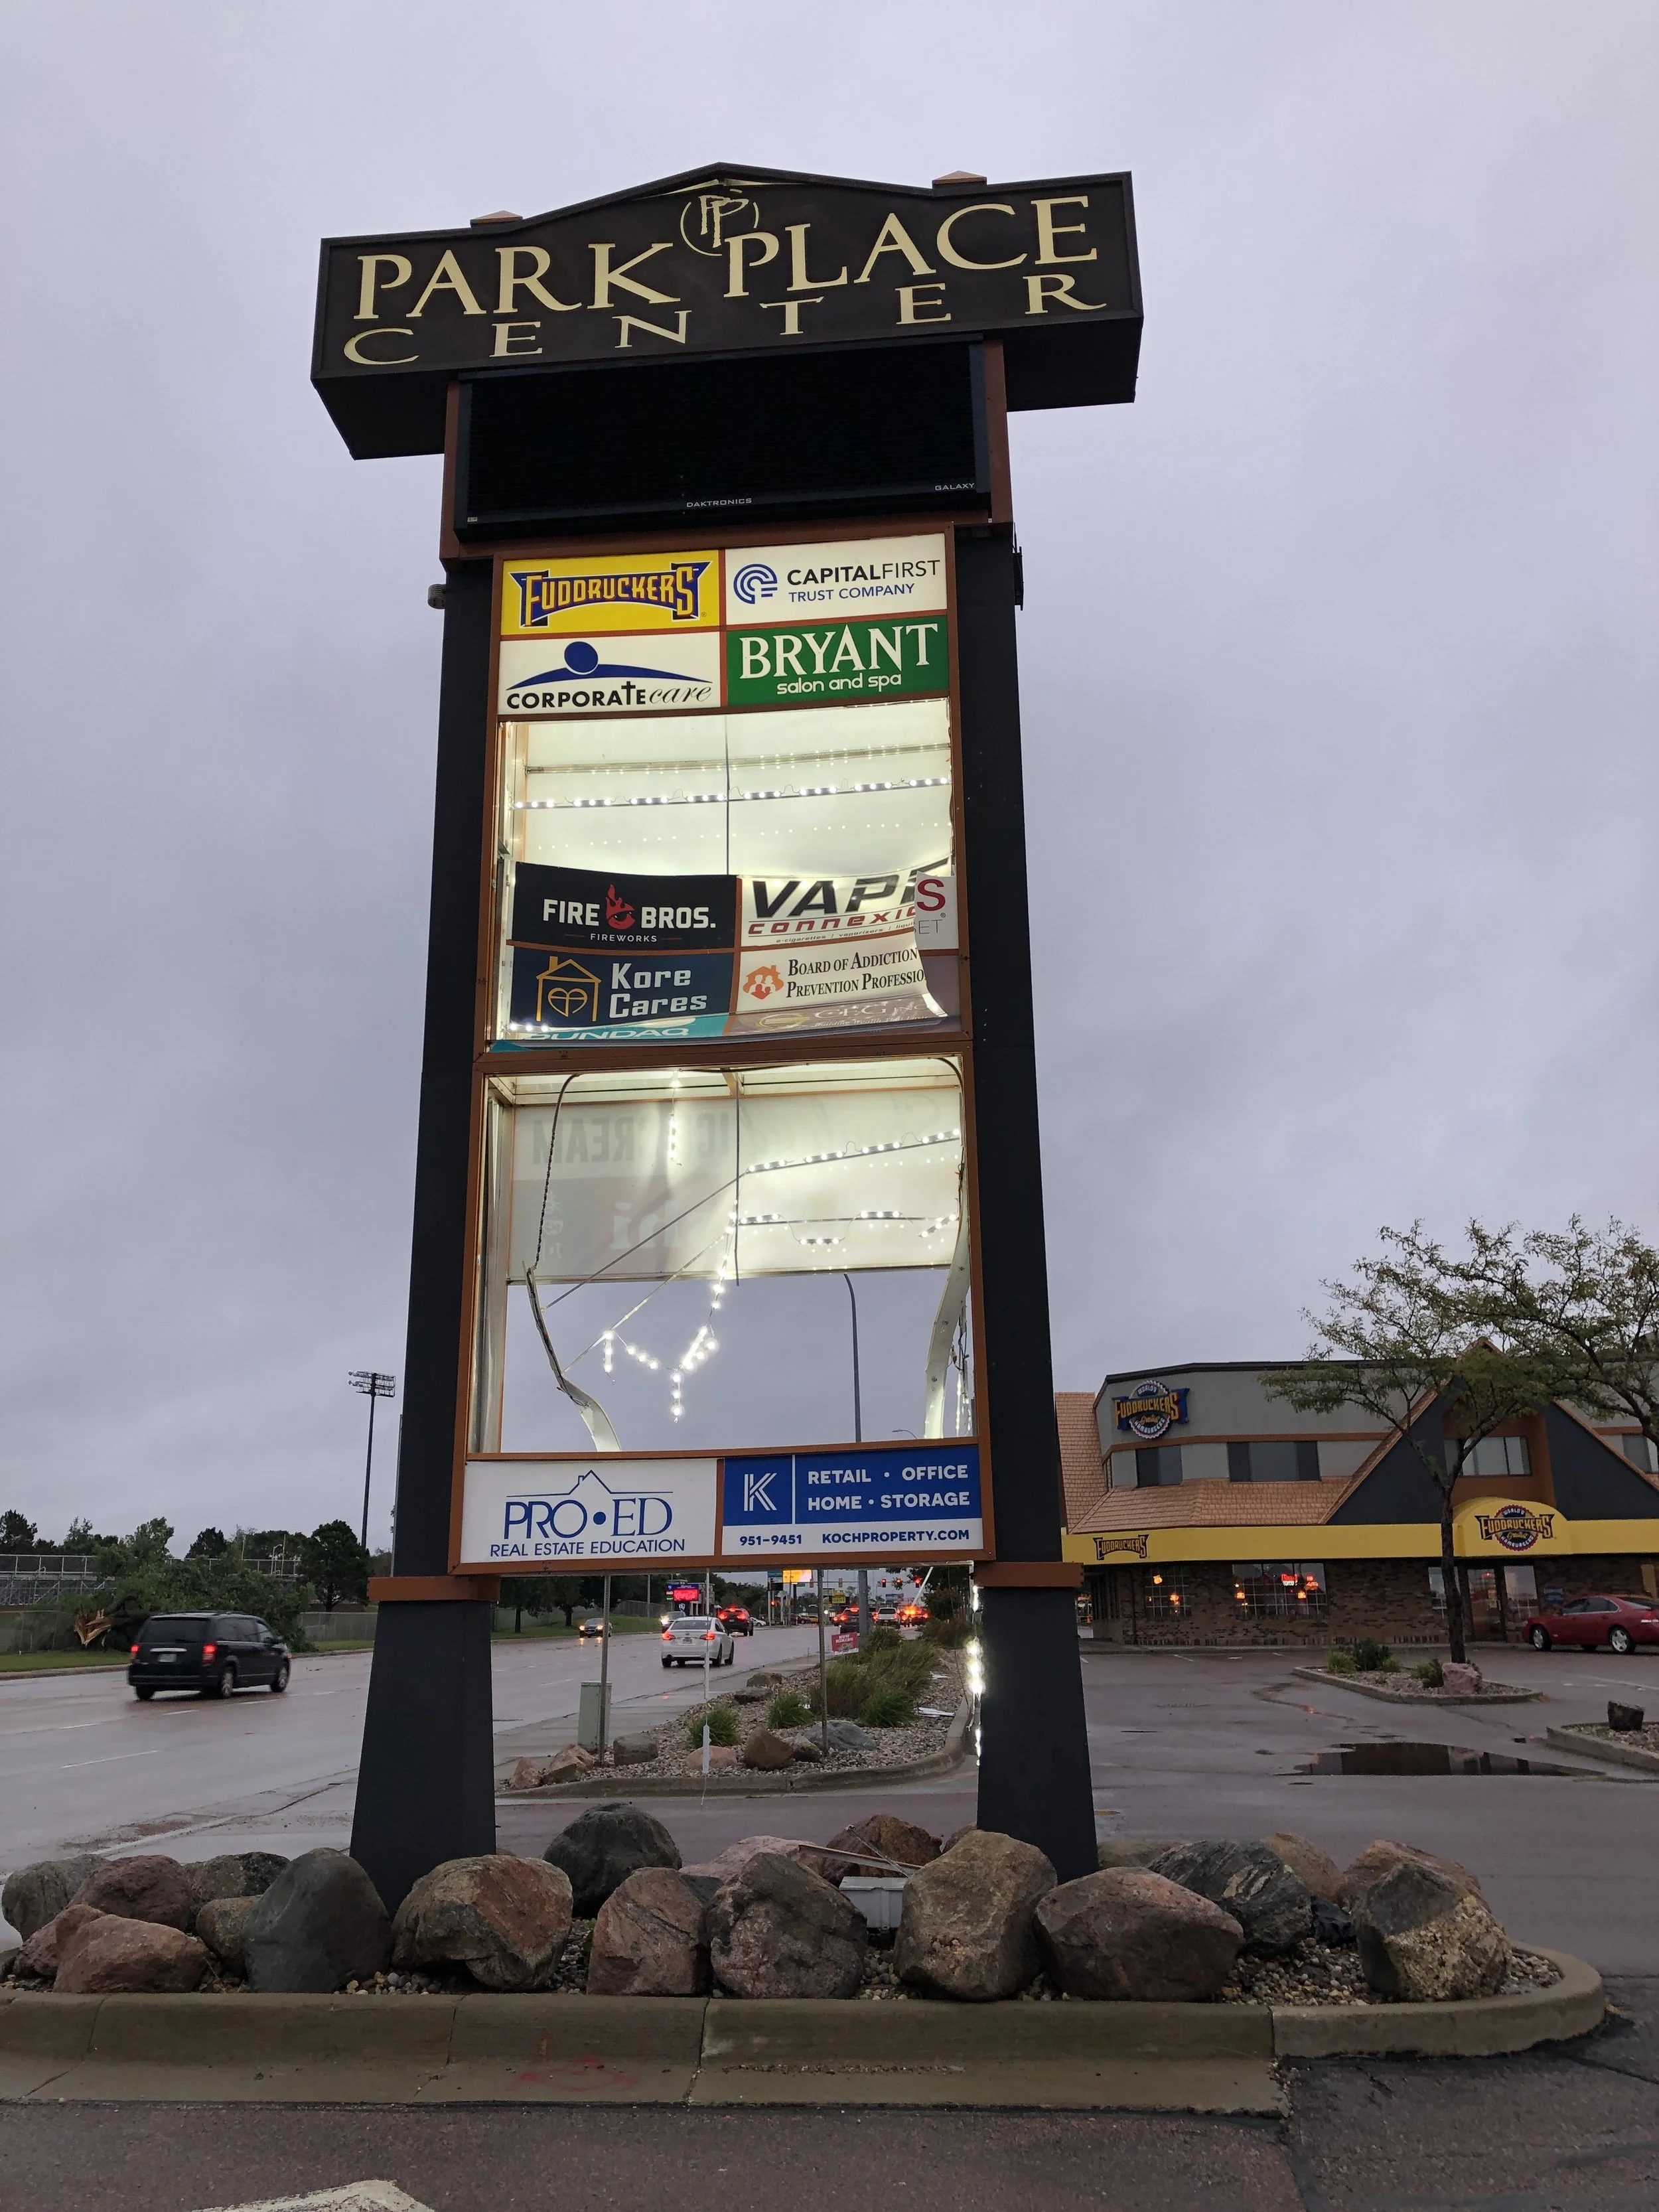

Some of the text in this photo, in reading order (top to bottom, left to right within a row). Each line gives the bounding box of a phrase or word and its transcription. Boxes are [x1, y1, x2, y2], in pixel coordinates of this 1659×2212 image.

[353, 195, 1098, 320] PARK PLACE
[343, 273, 1107, 366] CENTER
[934, 482, 975, 491] GALAXY
[685, 497, 753, 508] DAKTRONICS
[521, 565, 694, 627] FUDDRUCKERS
[788, 583, 915, 603] TRUST COMPANY
[739, 623, 938, 680] BRYANT
[776, 672, 902, 695] salon and spa
[542, 899, 717, 929] FIRE BROS.
[590, 932, 658, 943] FIREWORKS
[913, 919, 944, 934] ET
[788, 947, 918, 976] BOARD OF ADDICTION
[611, 962, 691, 990] Kore
[786, 969, 926, 998] PREVENTION PROFESSIO
[608, 993, 708, 1019] Cares
[1115, 1392, 1179, 1426] FUDDRUCKERS
[808, 1465, 968, 1485] RETAIL OFFICE
[808, 1491, 970, 1511] HOME STORAGE
[739, 1529, 970, 1546] 951-9451 KOCHPROPERTY.COM
[1480, 1515, 1551, 1538] FUDDRUCKERS
[490, 1538, 685, 1557] REAL ESTATE EDUCATION
[1096, 1536, 1146, 1559] FUDDRUCKERS
